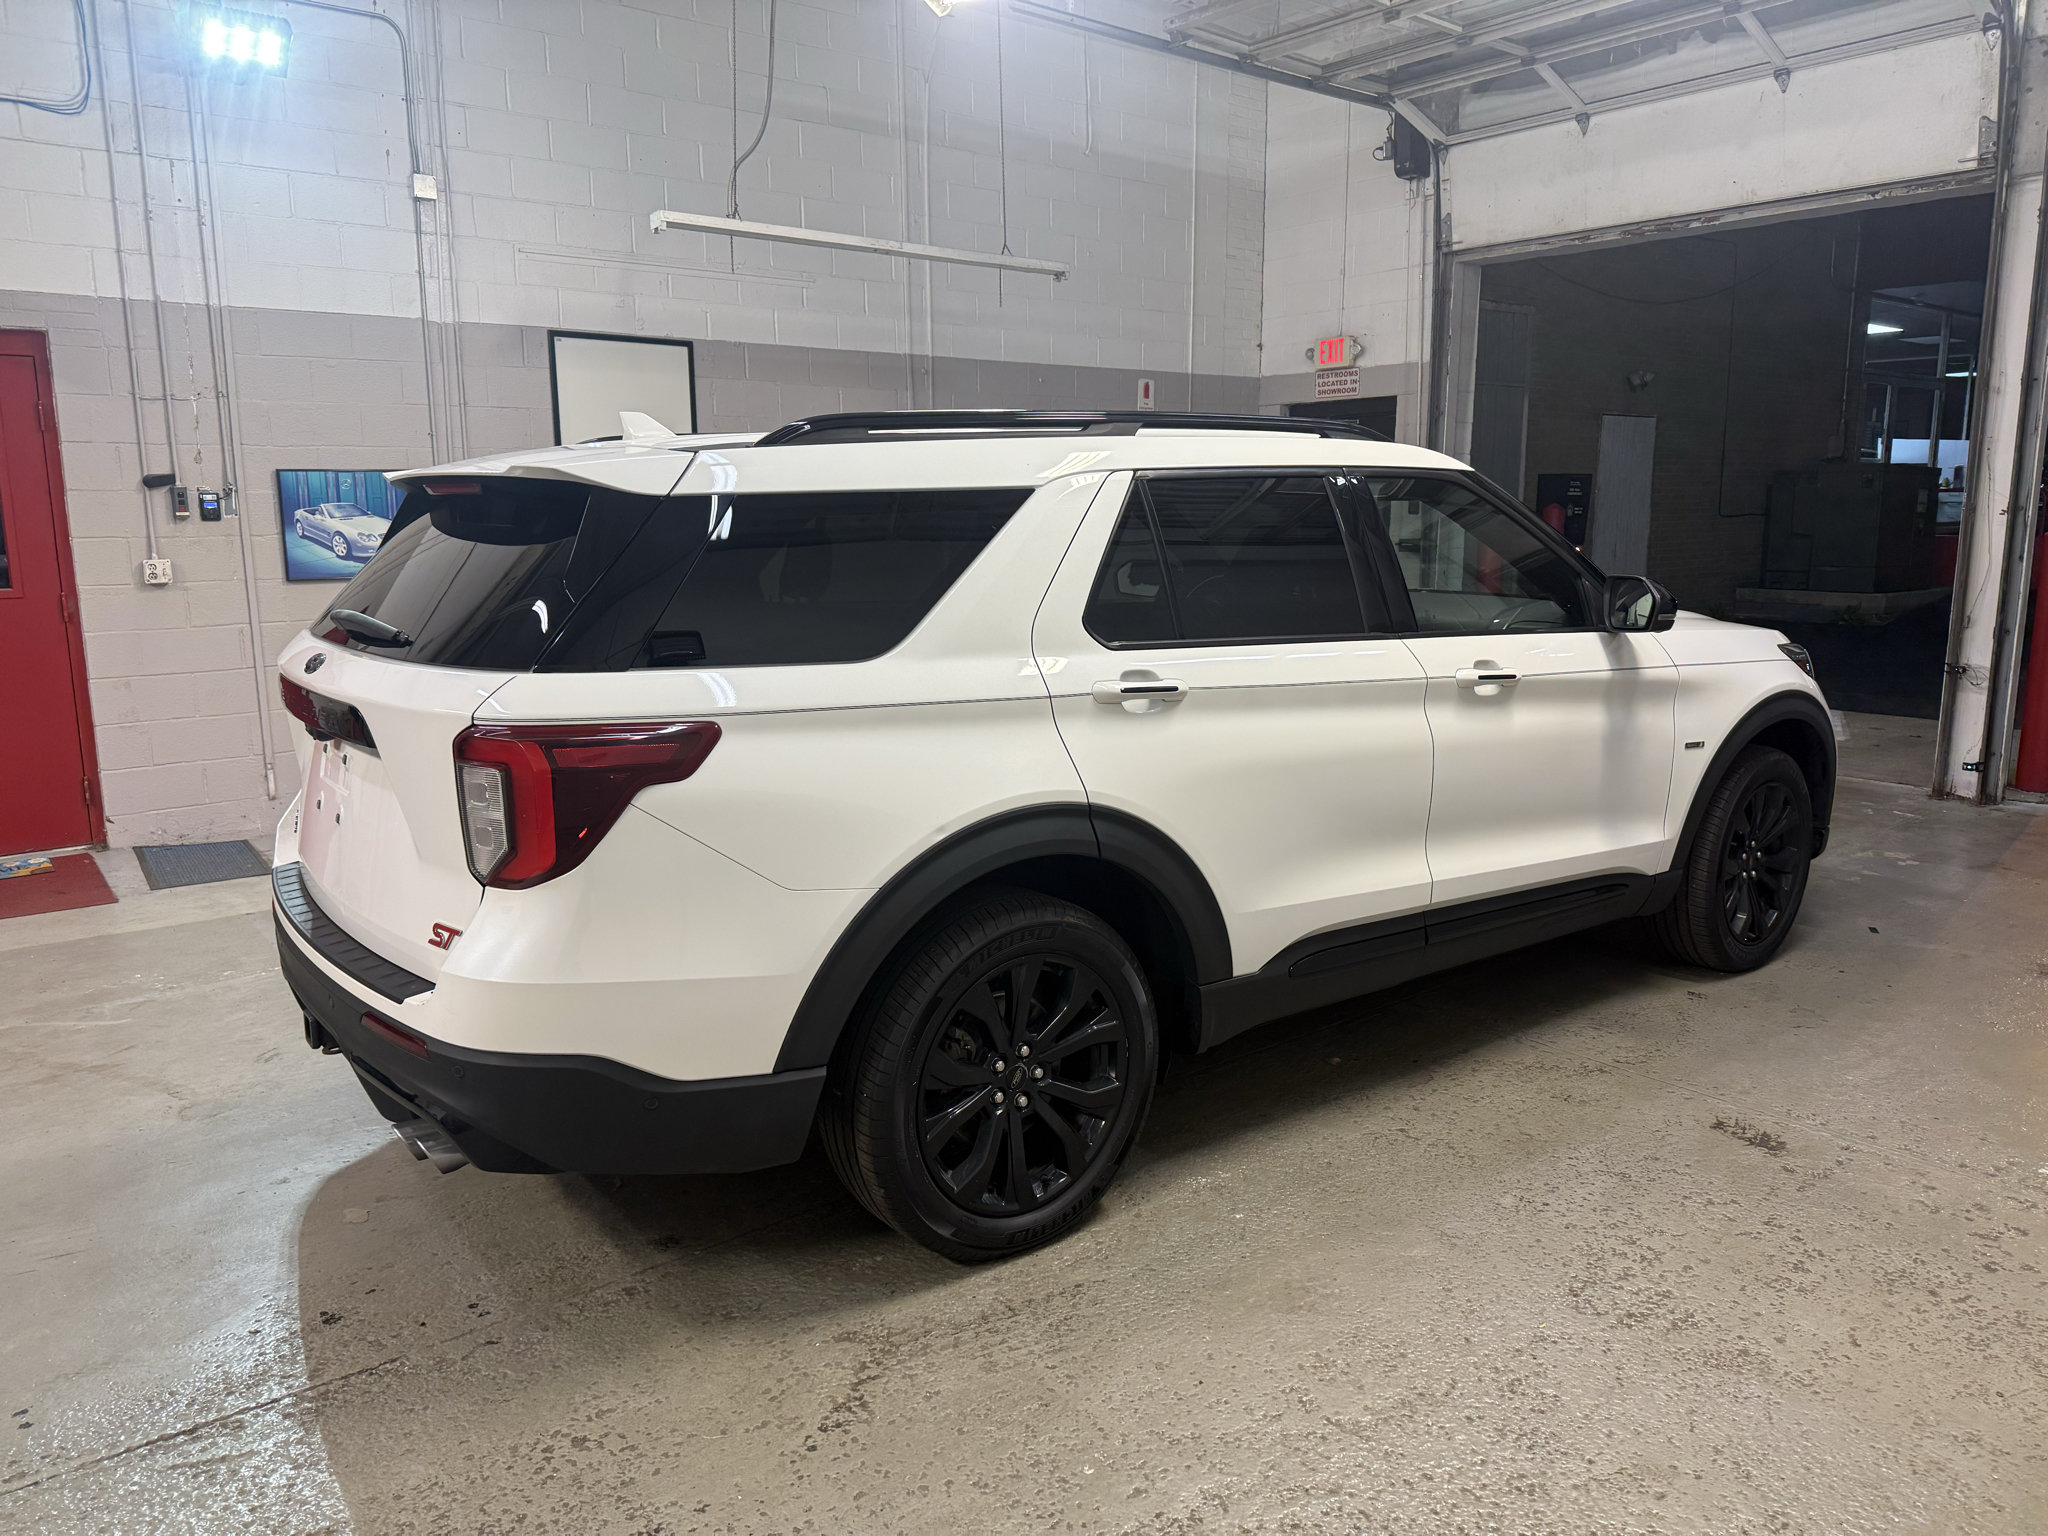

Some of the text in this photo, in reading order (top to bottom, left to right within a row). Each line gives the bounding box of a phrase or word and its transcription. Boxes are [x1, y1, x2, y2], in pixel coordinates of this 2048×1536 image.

[1320, 338, 1345, 364] EXIT
[1317, 370, 1359, 380] RESTROOMS
[1318, 380, 1348, 388] LOCATED
[1317, 387, 1358, 396] SHOWROOM
[428, 922, 463, 950] ST
